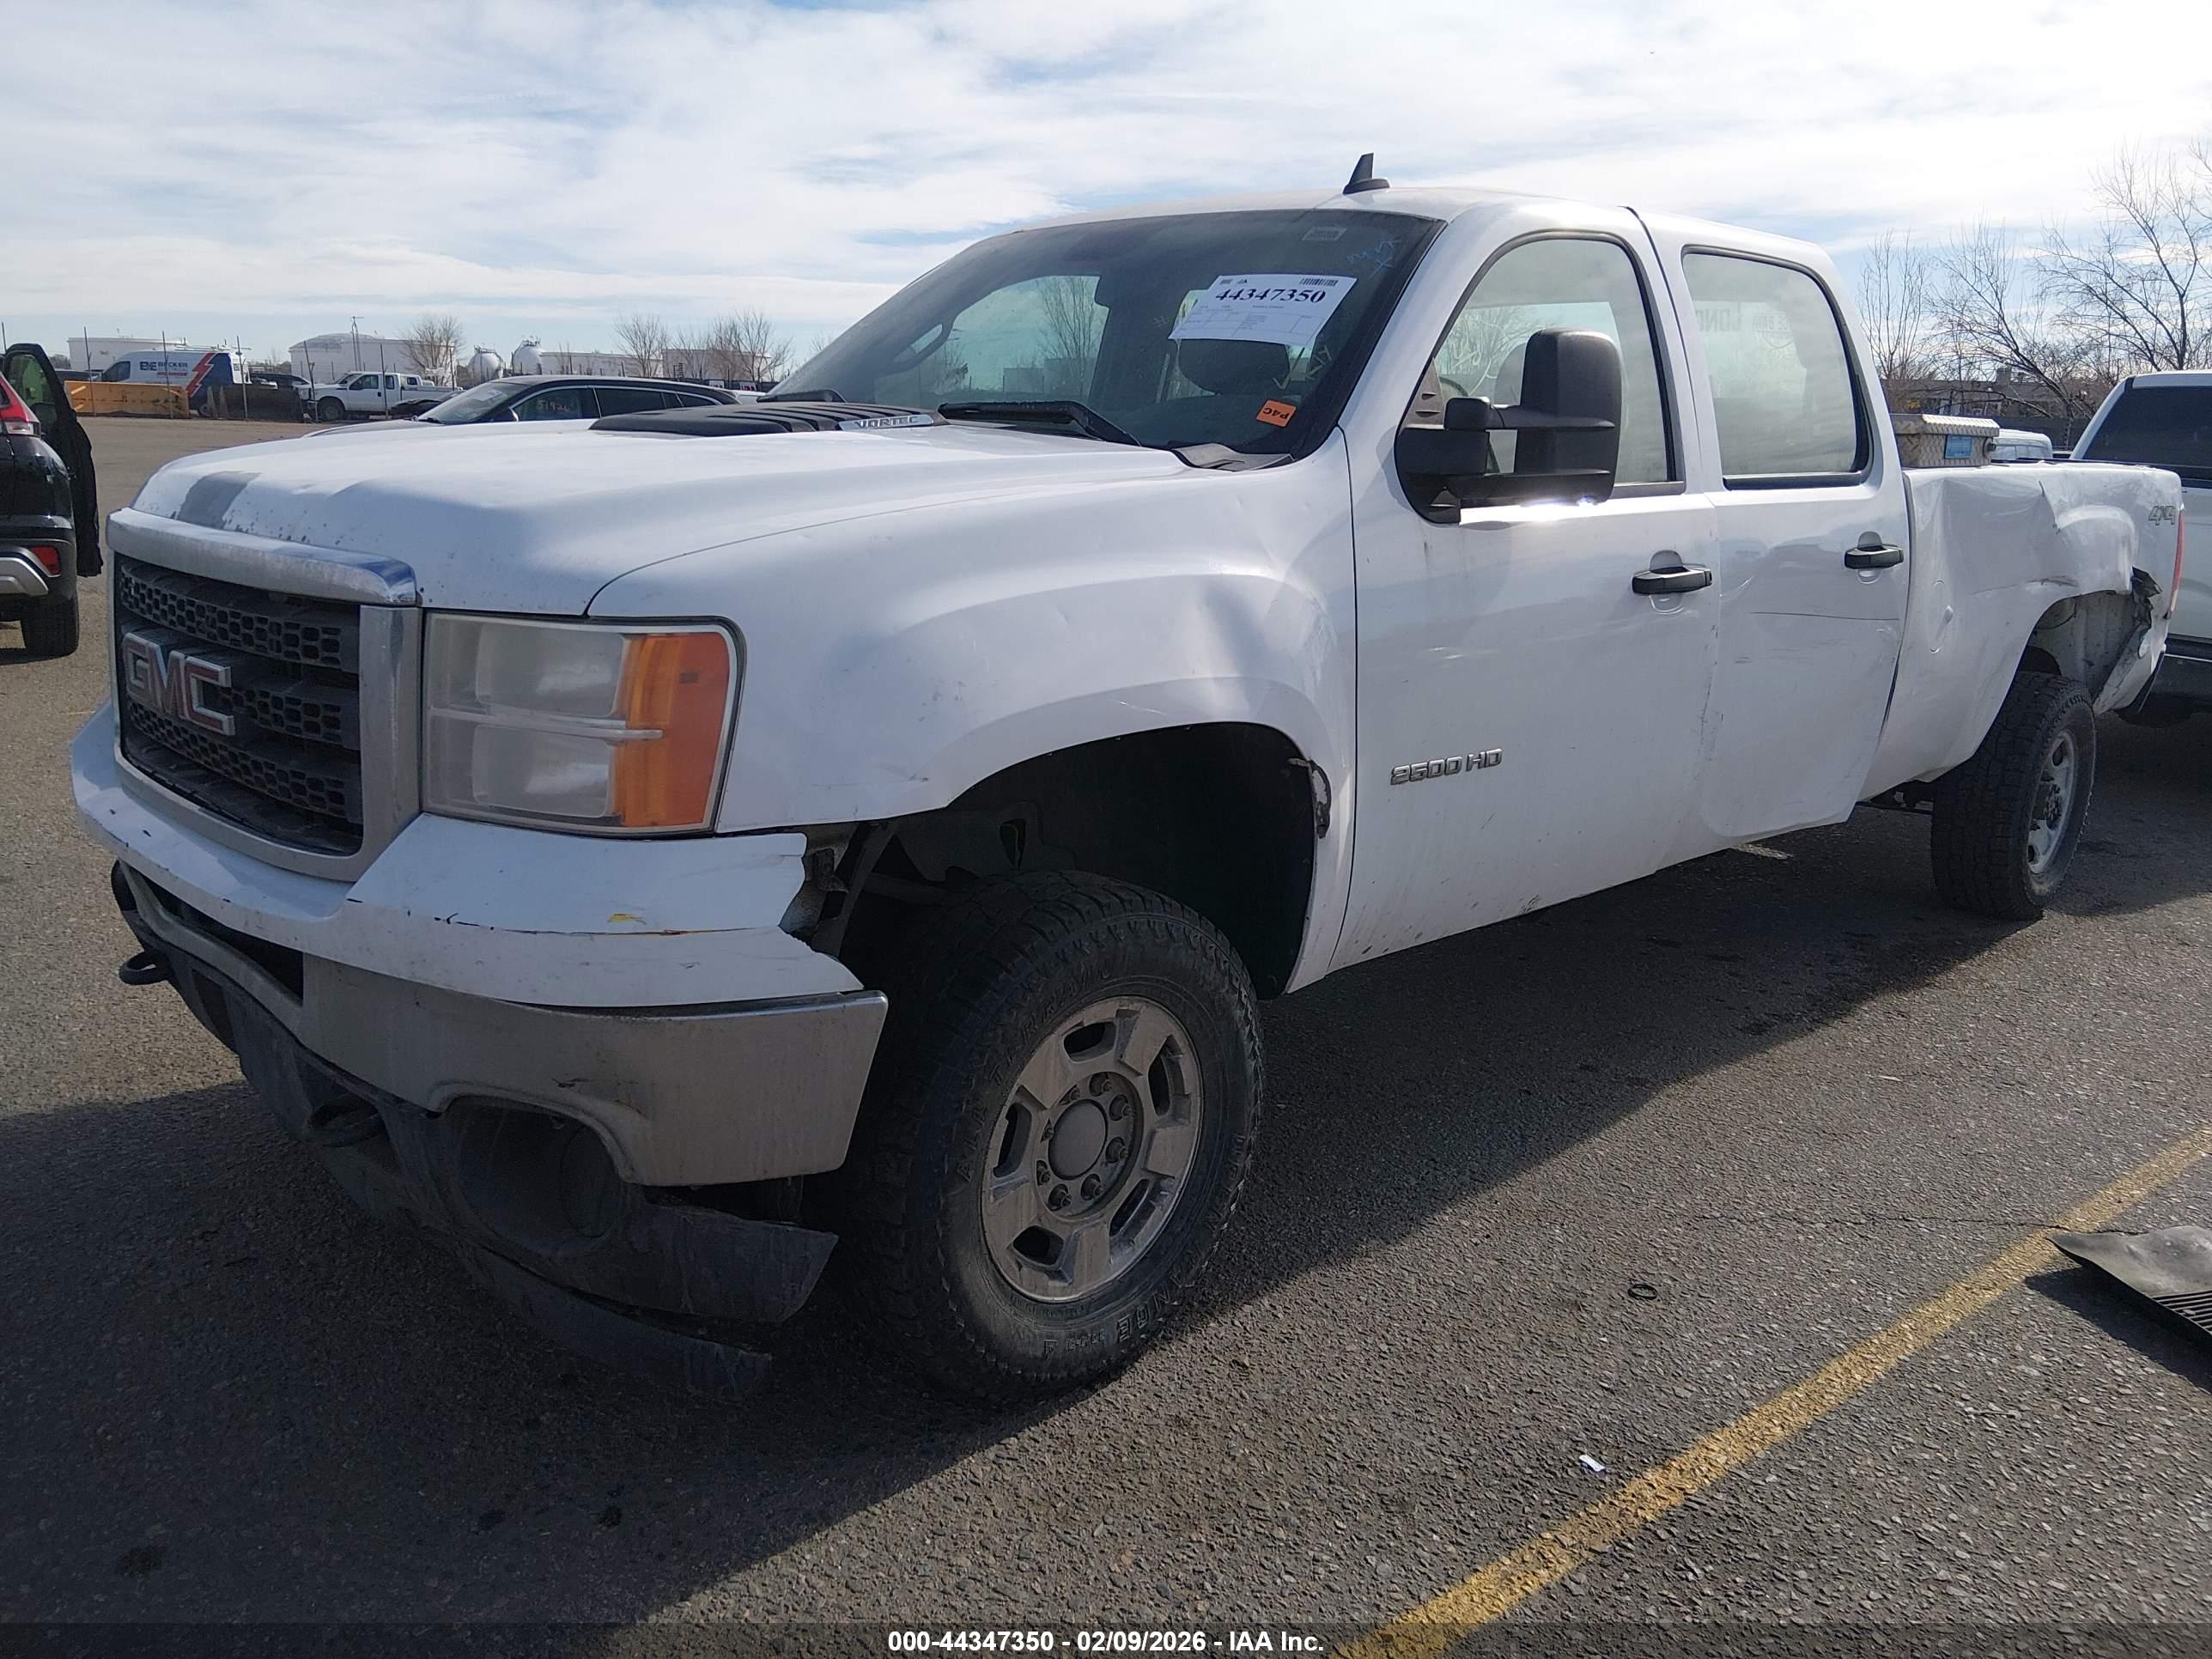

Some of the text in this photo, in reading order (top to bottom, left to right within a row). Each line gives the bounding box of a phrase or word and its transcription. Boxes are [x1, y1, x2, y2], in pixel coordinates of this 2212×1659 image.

[1216, 288, 1326, 303] 44347350
[854, 416, 919, 428] VORTEC
[122, 632, 235, 736] GMC
[1390, 748, 1503, 786] 2500 HD
